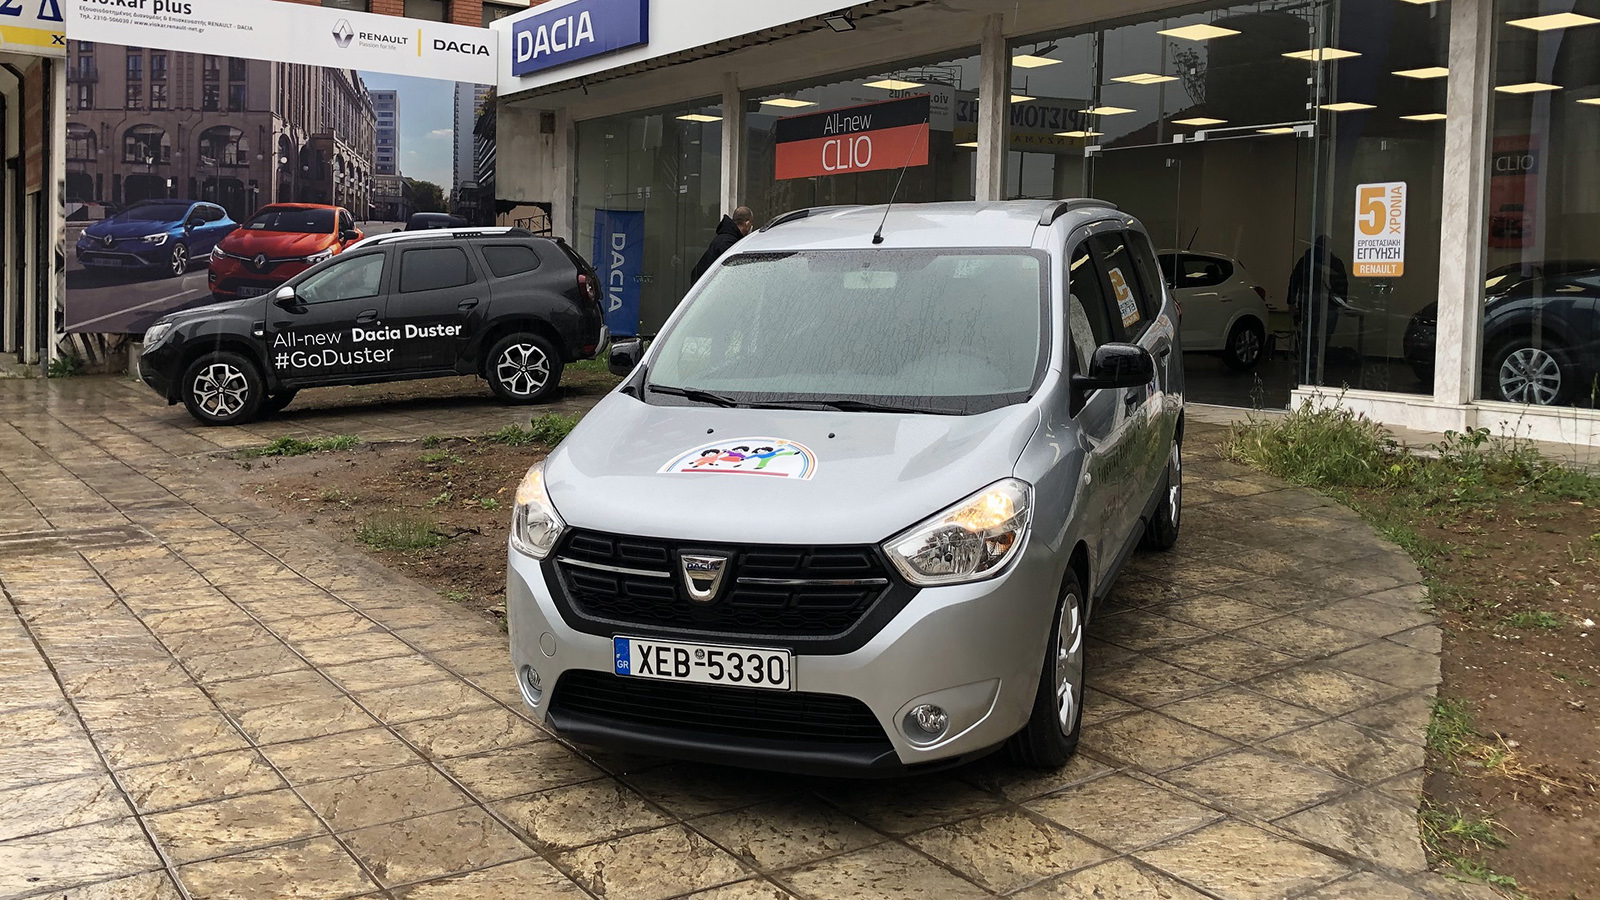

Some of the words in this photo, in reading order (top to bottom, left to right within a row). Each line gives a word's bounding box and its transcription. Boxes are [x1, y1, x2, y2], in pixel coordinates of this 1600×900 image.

[153, 0, 192, 15] plus
[207, 20, 232, 29] RENAULT
[359, 31, 408, 45] RENAULT
[359, 40, 378, 48] Passion
[517, 10, 595, 64] DACIA
[433, 39, 490, 56] DACIA
[824, 113, 872, 135] All-new
[822, 135, 872, 171] CLIO
[1496, 155, 1534, 171] CLIO
[1358, 187, 1387, 236] 5
[1389, 186, 1403, 234] ΧΡΟΝΙΑ
[1357, 239, 1401, 247] ΕΡΓΟΣΤΑΣΙΑΚΗ
[1357, 247, 1401, 260] ΕΓΓΥΗΣΗ
[608, 233, 626, 312] DACIA
[1360, 264, 1397, 274] RENAULT
[273, 331, 342, 348] All-new
[352, 326, 401, 343] Dacia
[405, 324, 462, 339] Duster
[274, 347, 394, 370] #GoDuster
[686, 562, 717, 570] DACIA
[617, 659, 629, 669] GR
